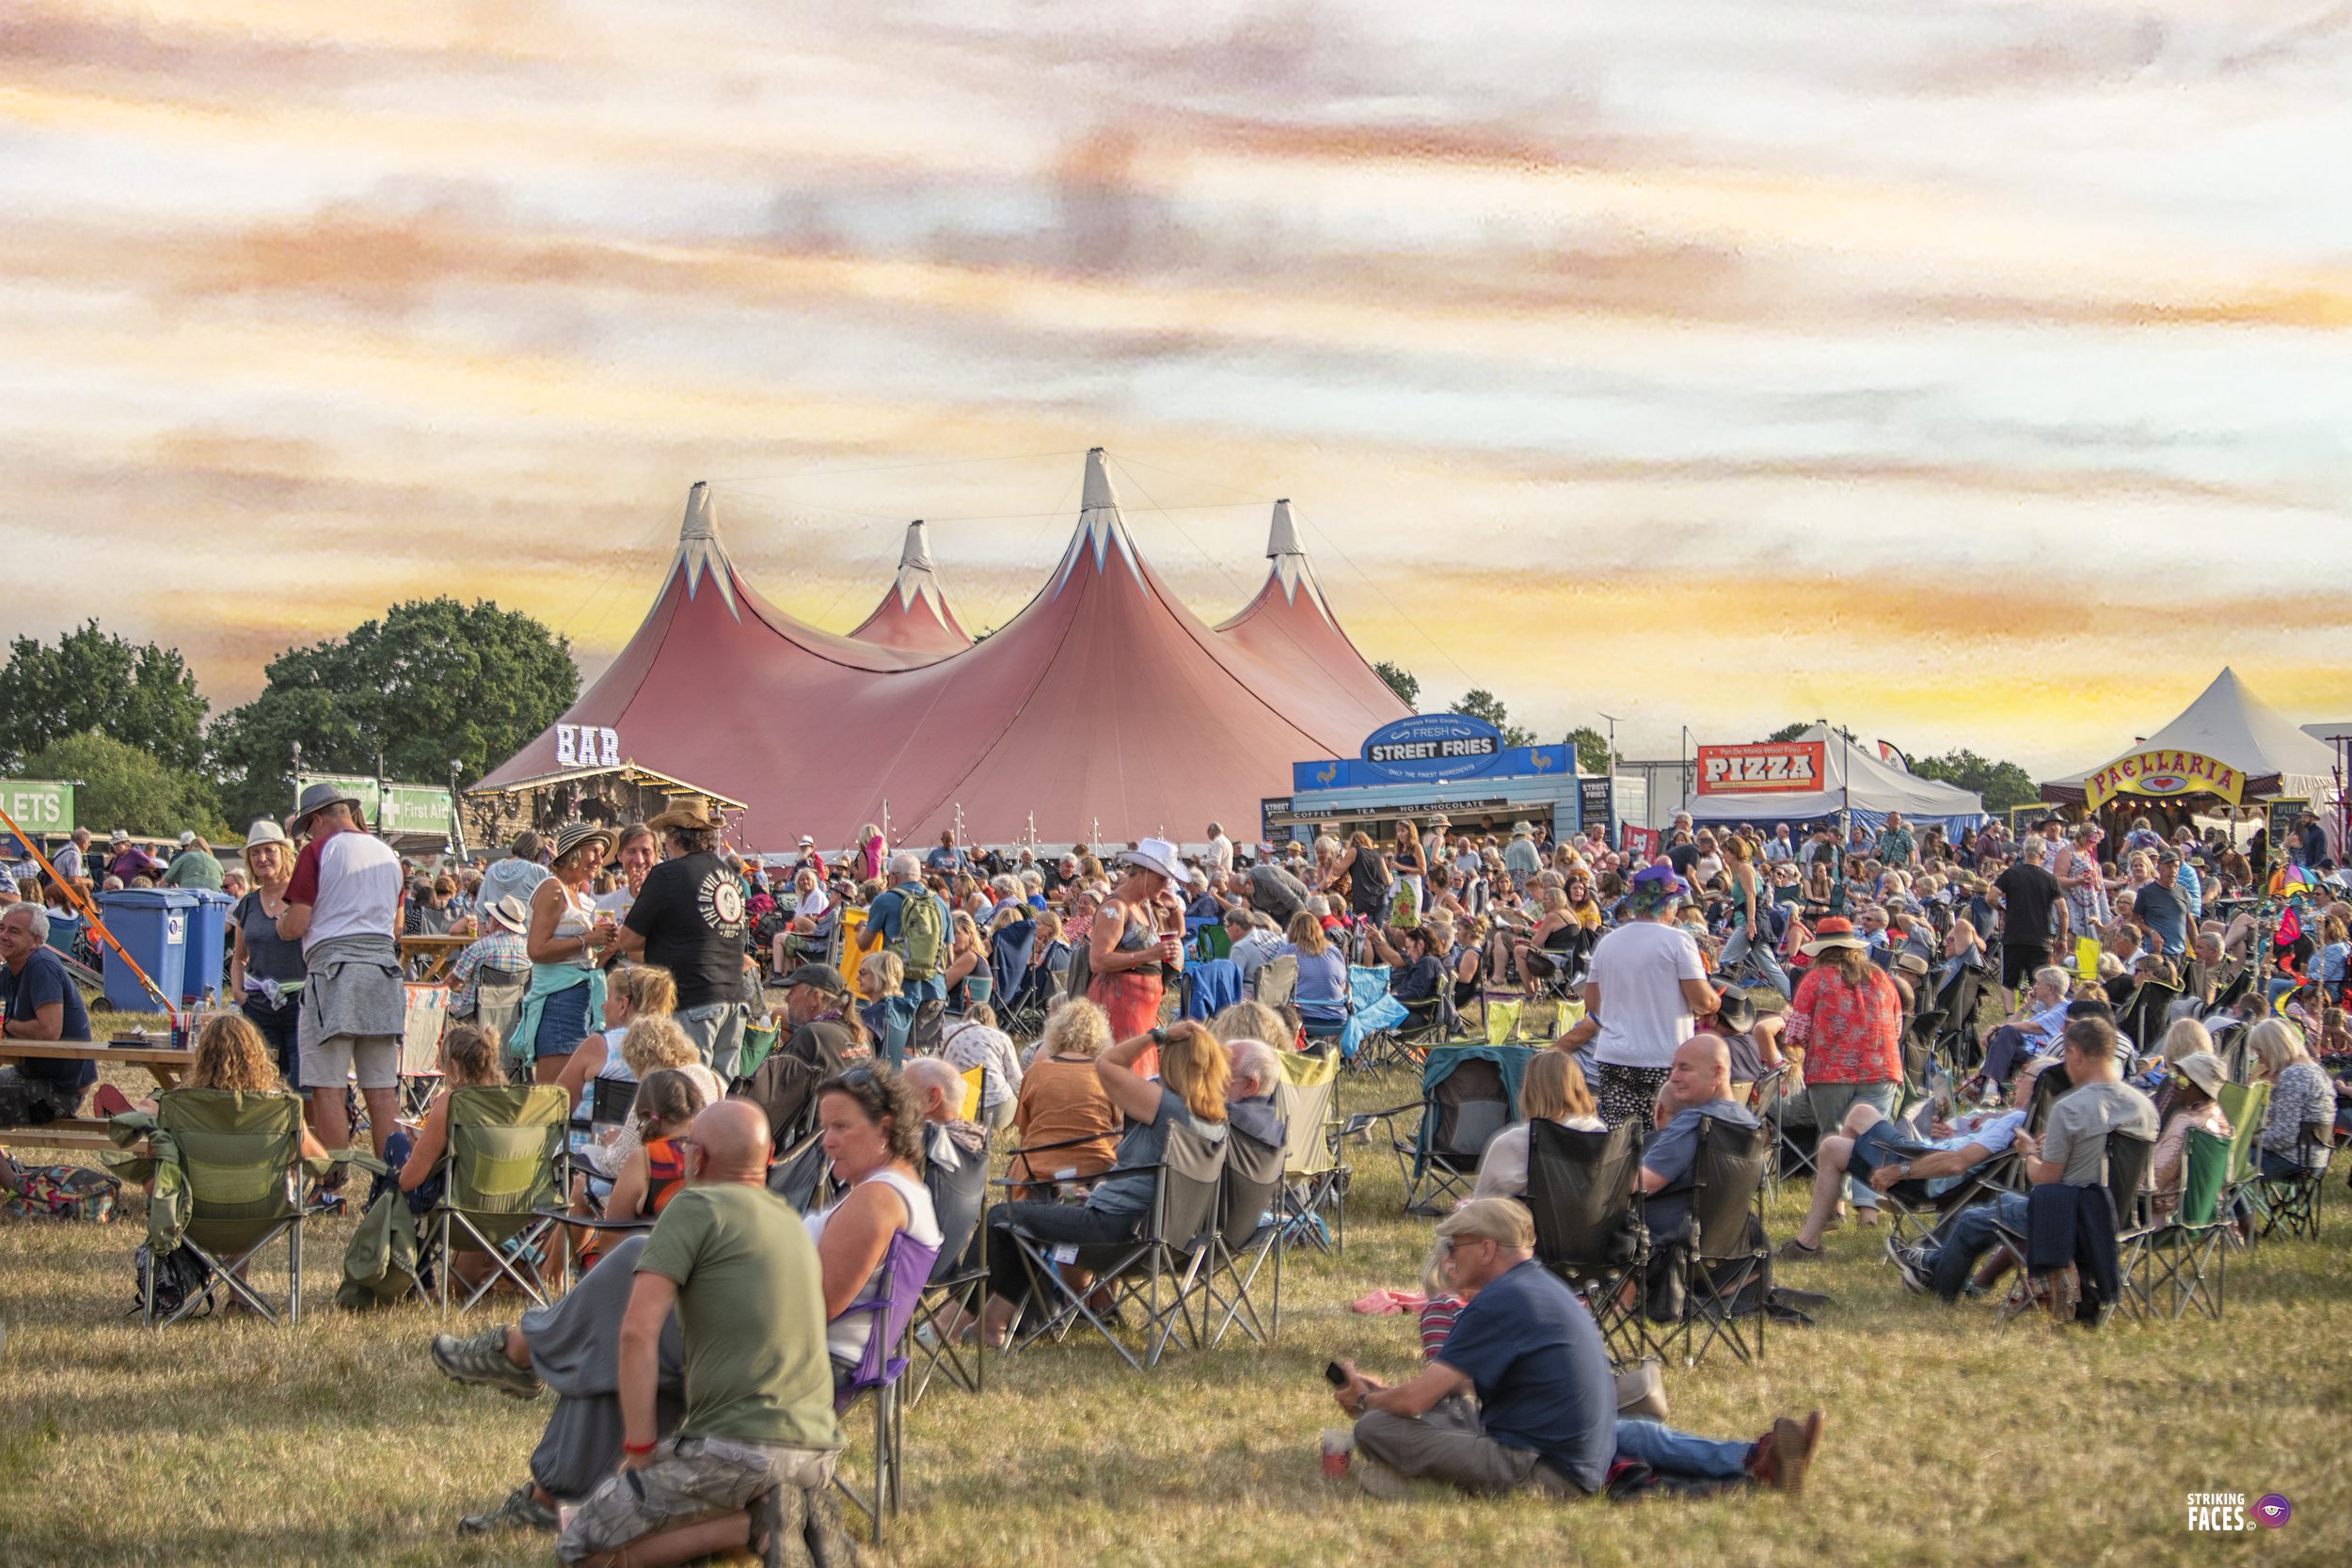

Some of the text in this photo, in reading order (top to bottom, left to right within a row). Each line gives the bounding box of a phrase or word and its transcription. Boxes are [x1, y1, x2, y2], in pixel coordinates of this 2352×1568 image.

[1413, 727, 1449, 737] FRESH
[556, 723, 620, 767] BAR
[1373, 737, 1493, 762] STREET FRIES
[1705, 755, 1815, 782] PIZZA
[2092, 752, 2233, 797] PAELLARIA
[1581, 783, 1610, 792] STREET
[404, 801, 449, 820] First Aid
[1264, 802, 1290, 812] STREET
[1295, 811, 1333, 819] COFFEE
[1423, 800, 1486, 811] CHOCOLATE
[698, 872, 720, 903] DEVIL
[699, 905, 721, 929] THE
